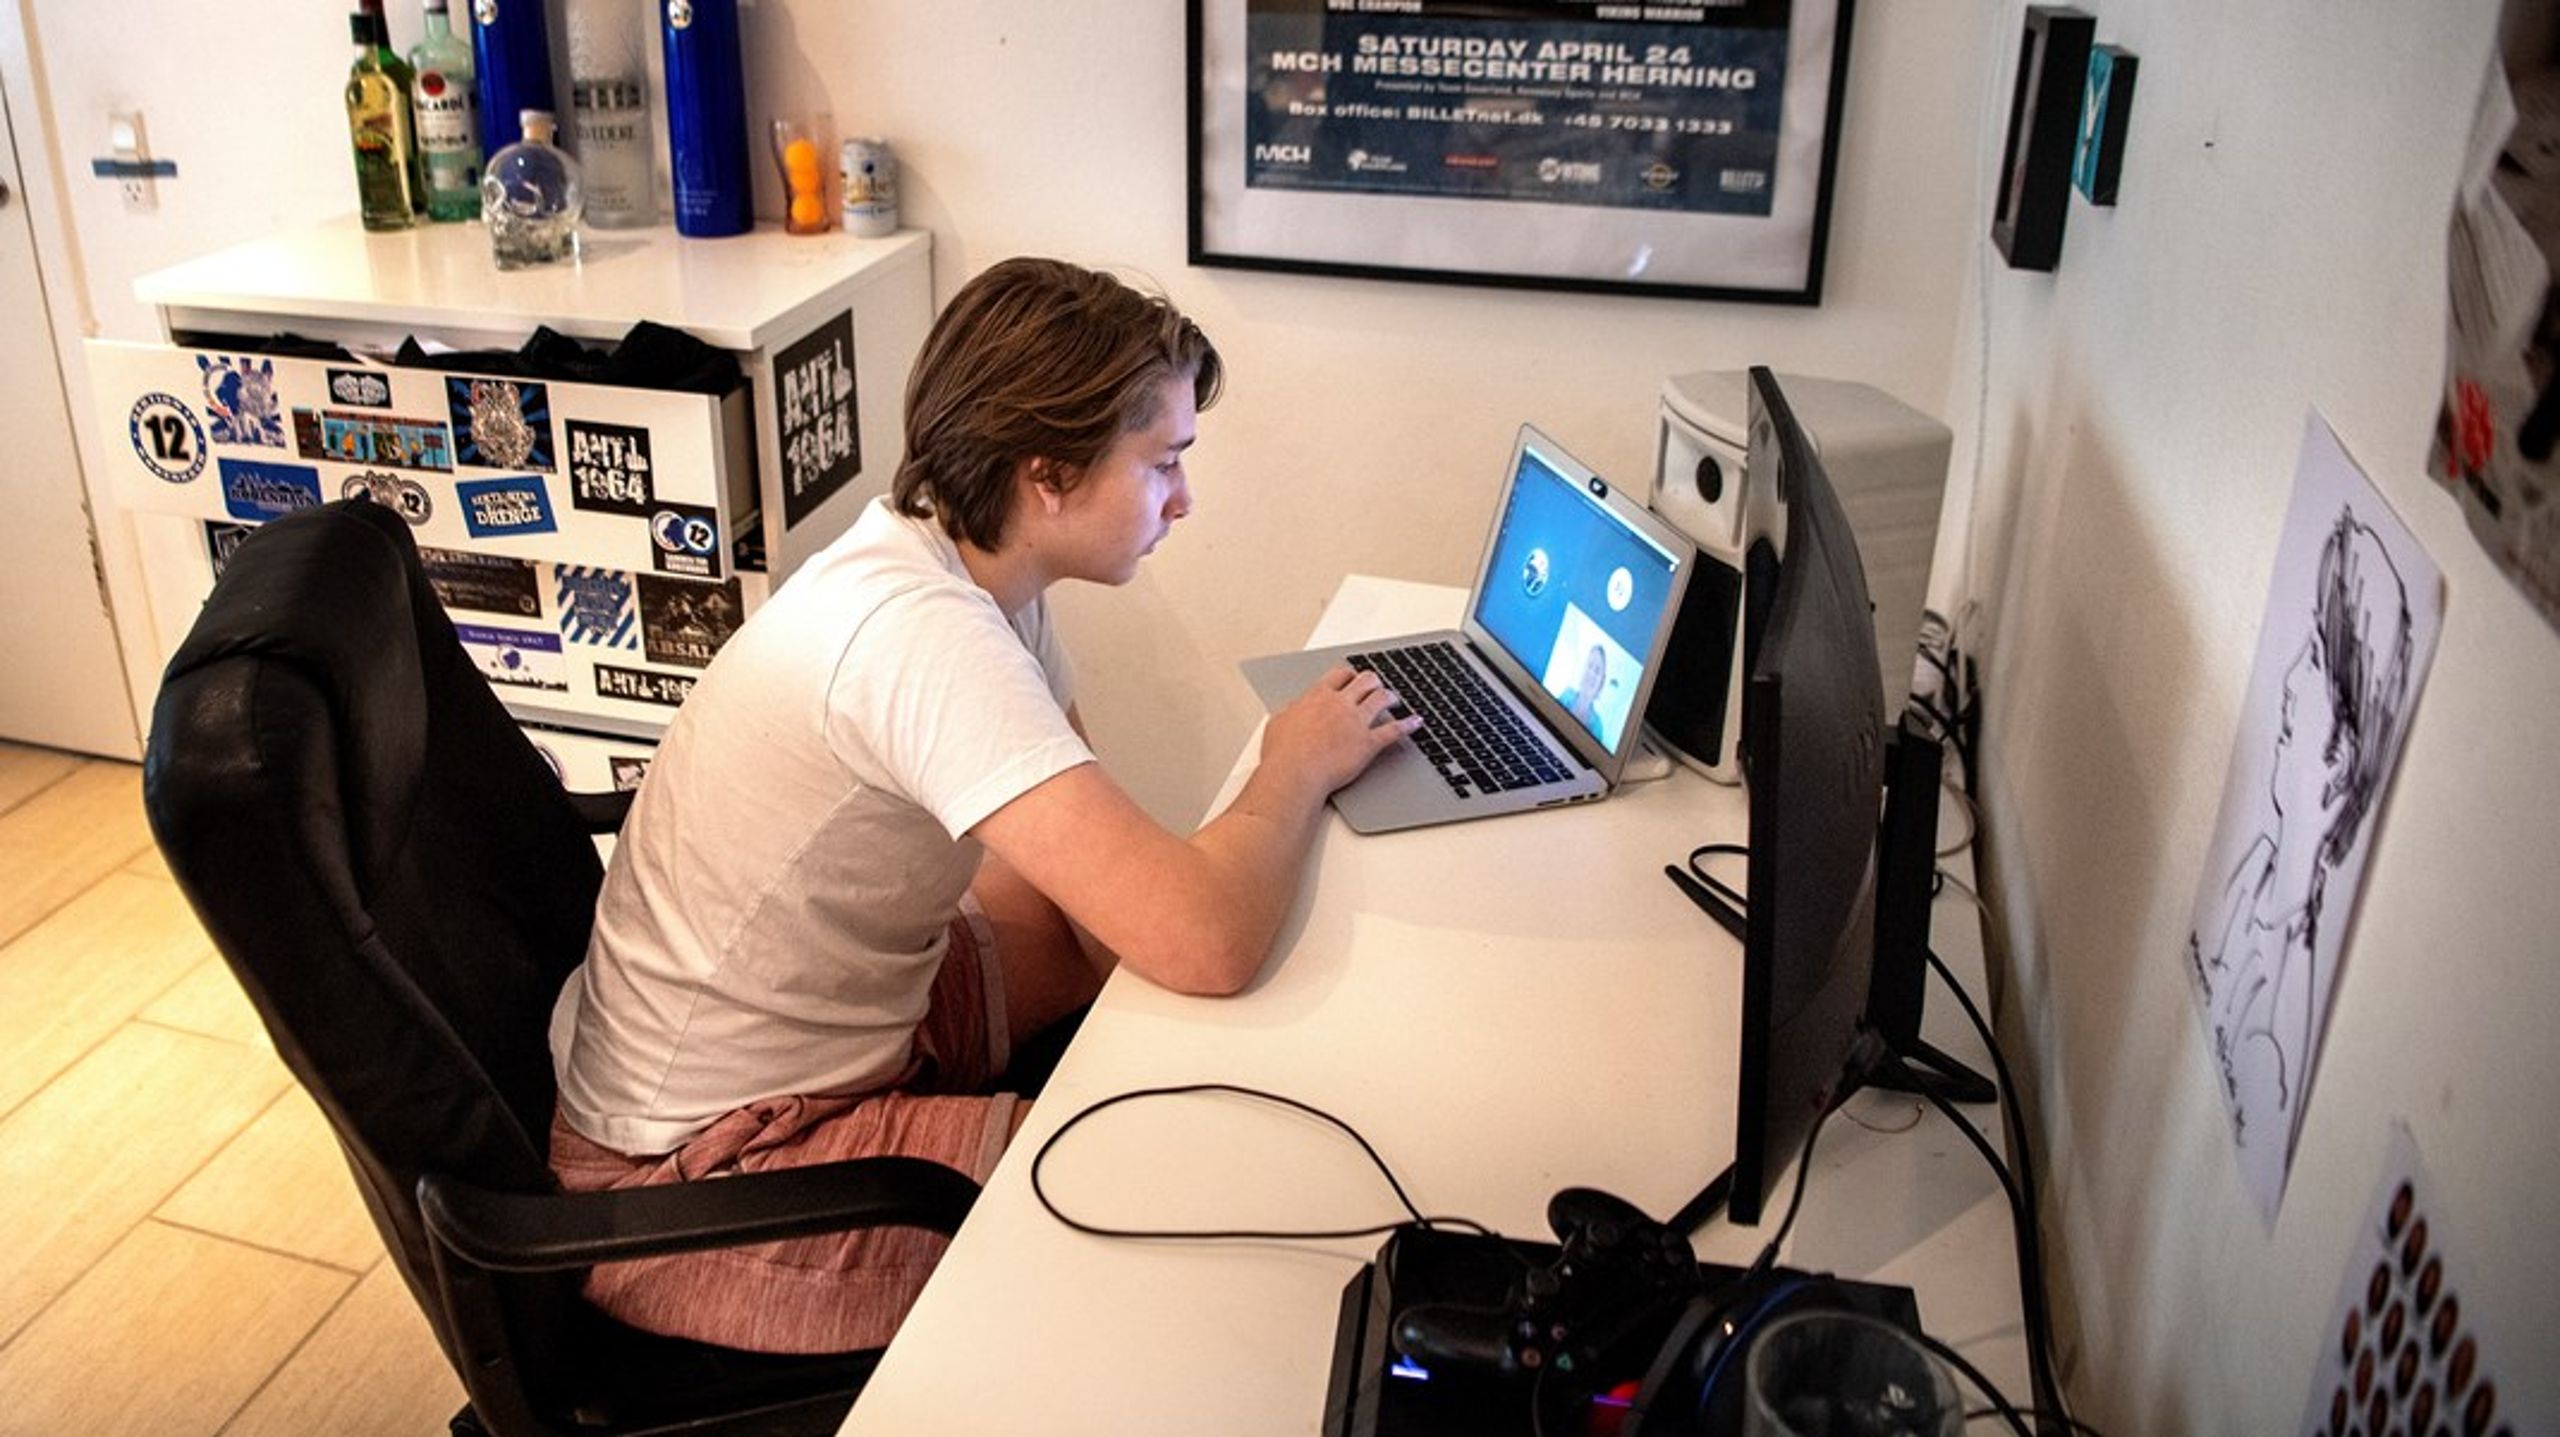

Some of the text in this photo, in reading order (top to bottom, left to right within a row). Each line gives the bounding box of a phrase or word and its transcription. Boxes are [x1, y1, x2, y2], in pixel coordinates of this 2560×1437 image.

[1358, 34, 1692, 66] SATURDAY APRIL 24
[1272, 52, 1756, 89] MCH MESSECENTER HERNING
[1289, 102, 1329, 116] Box
[1334, 103, 1400, 120] office:
[1255, 145, 1311, 163] MCH
[144, 415, 191, 462] 12
[787, 402, 851, 496] 1964
[574, 466, 646, 505] 1964
[402, 492, 420, 515] 12
[690, 524, 710, 549] 12
[647, 640, 713, 659] ABSAL
